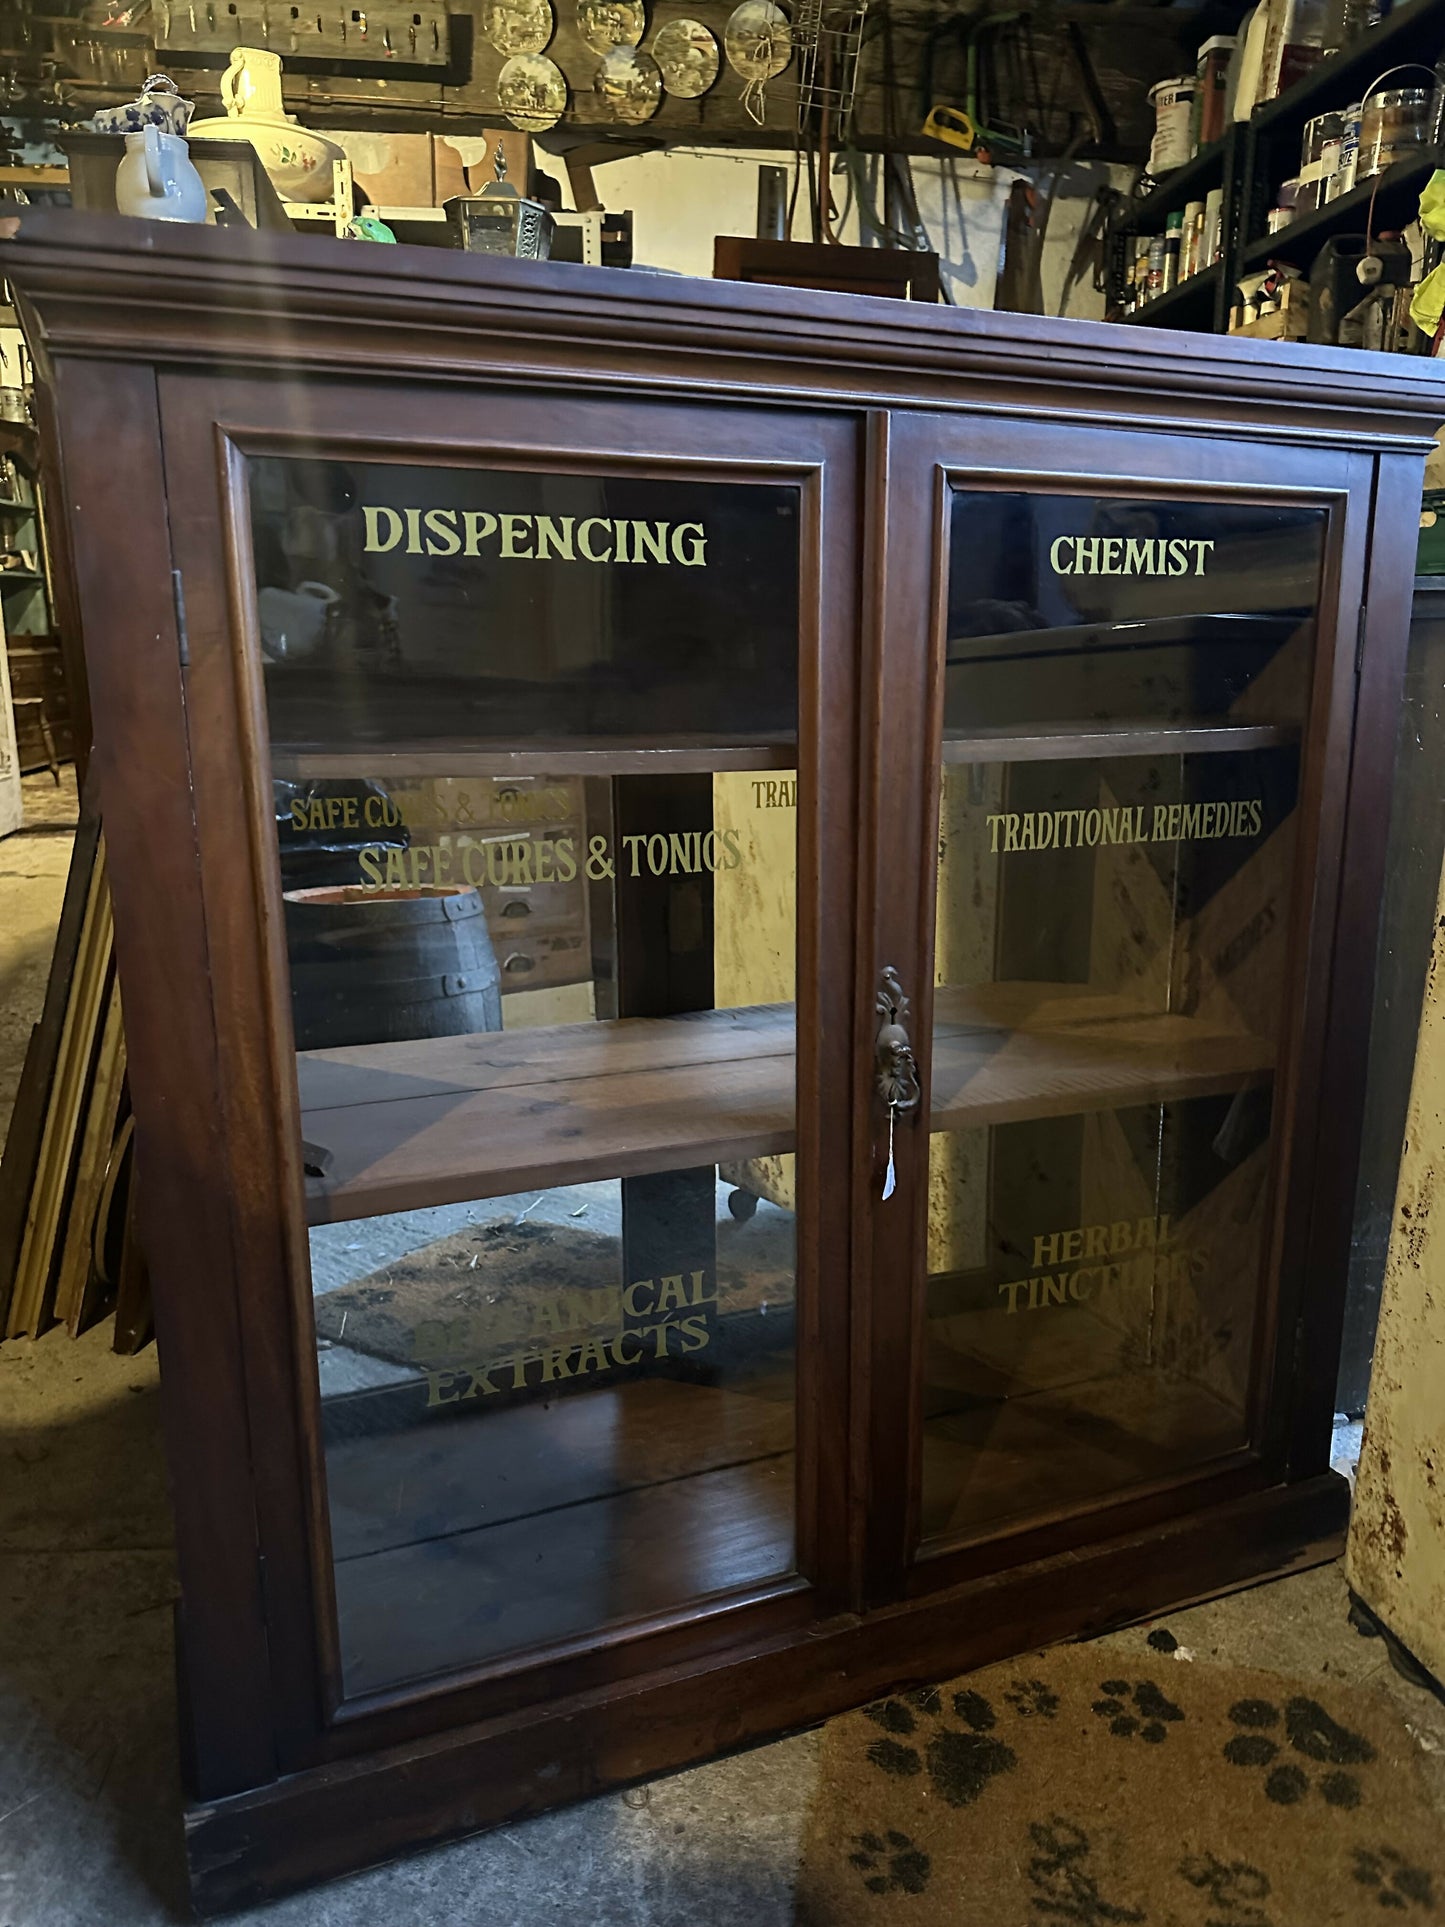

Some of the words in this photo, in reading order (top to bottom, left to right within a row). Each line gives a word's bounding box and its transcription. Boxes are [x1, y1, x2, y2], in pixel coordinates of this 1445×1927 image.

[362, 505, 708, 566] DISPENCING
[1050, 535, 1214, 576] CHEMIST
[290, 797, 360, 831] SAFE
[986, 806, 1149, 853] TRADITIONAL
[1151, 800, 1263, 841] REMEDIES
[358, 846, 454, 895] SAFE
[461, 837, 578, 888] CURES
[585, 835, 616, 881] &
[622, 828, 742, 878] TONICS
[1031, 1214, 1180, 1269] HERBAL
[425, 1313, 711, 1407] EXTRACTS
